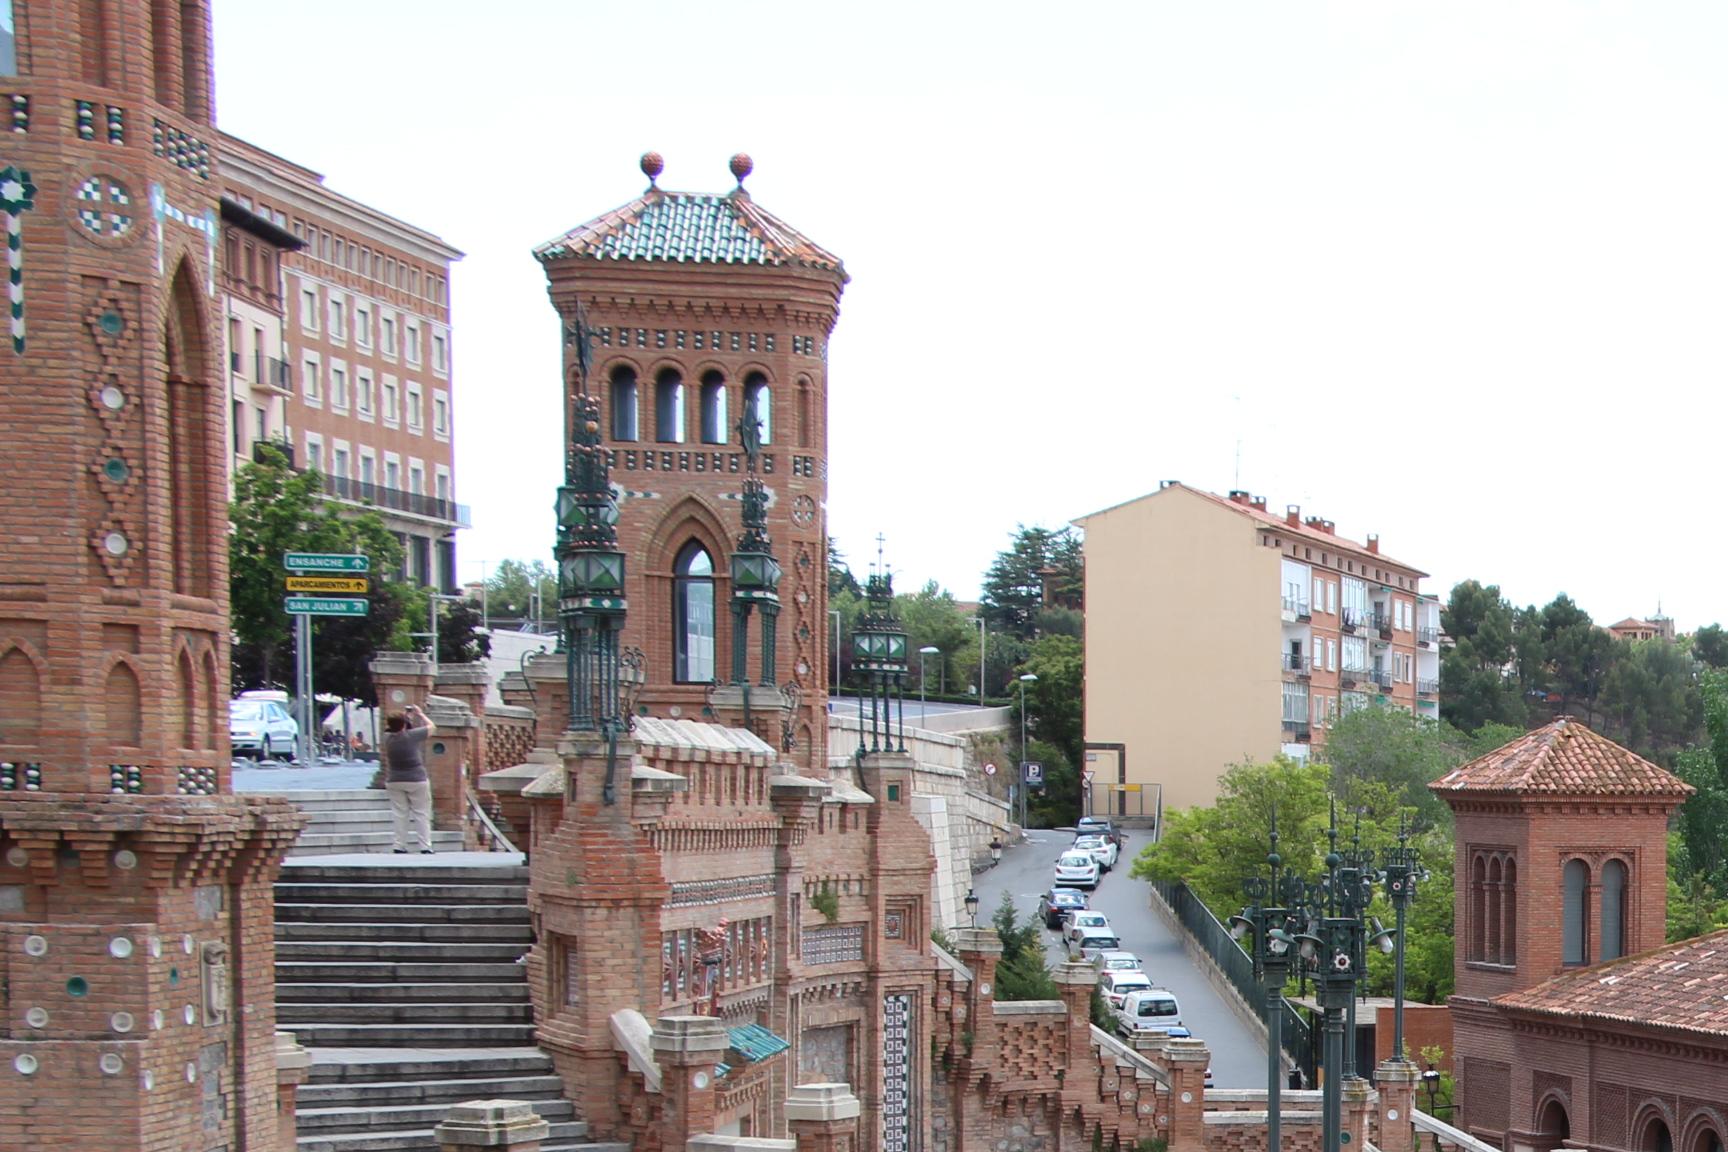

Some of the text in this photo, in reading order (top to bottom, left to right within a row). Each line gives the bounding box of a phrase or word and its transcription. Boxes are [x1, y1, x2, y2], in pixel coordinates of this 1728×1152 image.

[288, 557, 344, 568] ENSANCHE
[290, 580, 350, 589] APARCAMIENTOS
[289, 601, 347, 611] SAN JULIAN
[1029, 765, 1040, 777] P
